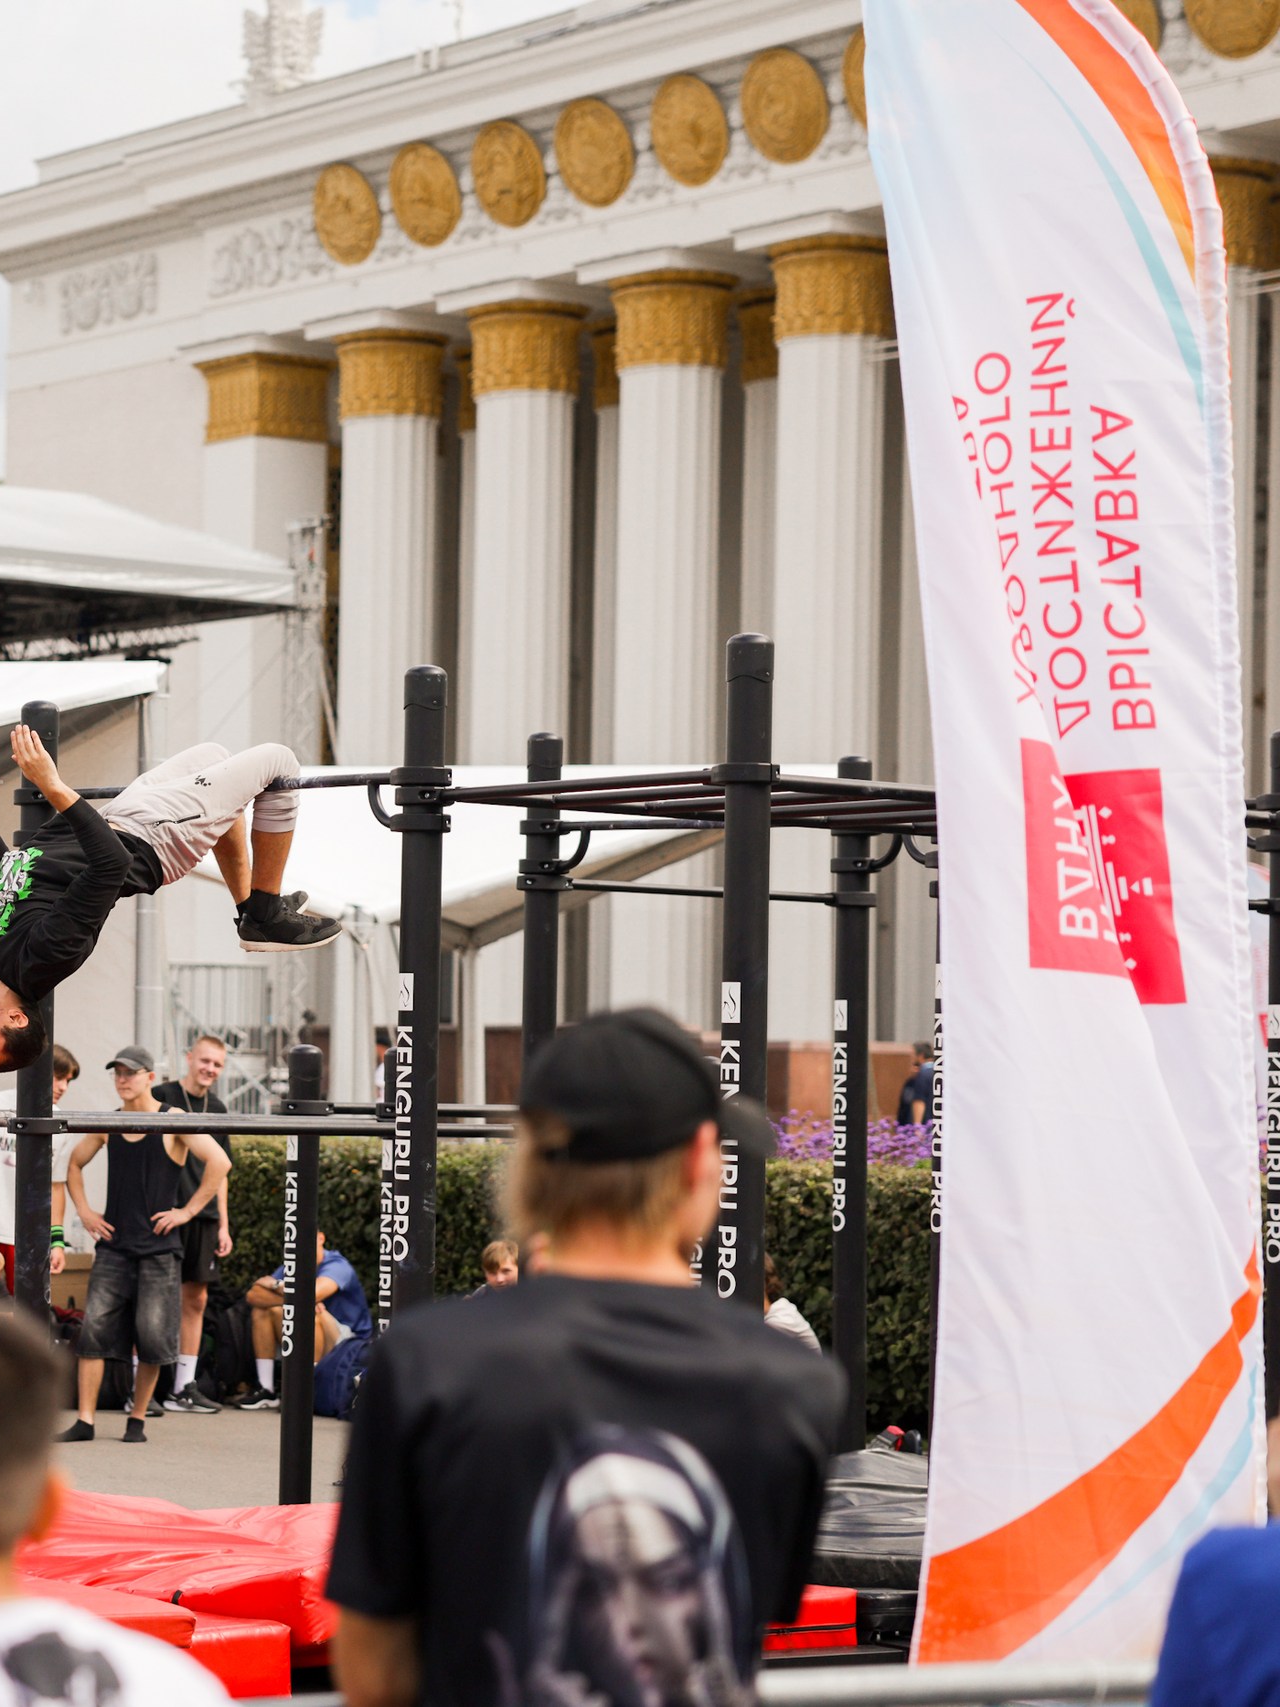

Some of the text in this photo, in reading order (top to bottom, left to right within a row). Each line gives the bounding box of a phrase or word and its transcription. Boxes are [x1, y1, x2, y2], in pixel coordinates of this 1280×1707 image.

[392, 1025, 413, 1262] KENGURU PRO
[717, 1039, 741, 1300] KENURU PRO
[831, 1042, 848, 1233] KENGURU PRO
[281, 1171, 298, 1358] KENGURU PRO
[378, 1181, 393, 1308] KENGURU
[1267, 1201, 1280, 1265] PRO
